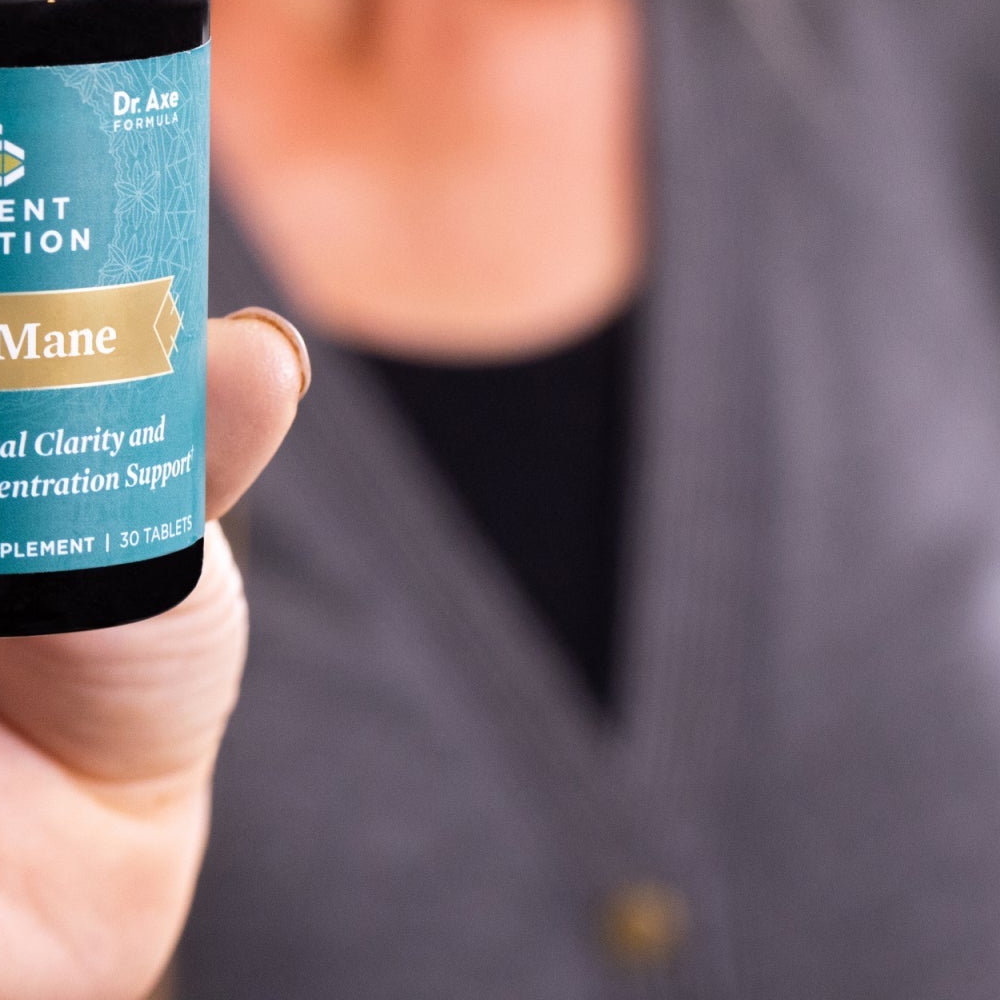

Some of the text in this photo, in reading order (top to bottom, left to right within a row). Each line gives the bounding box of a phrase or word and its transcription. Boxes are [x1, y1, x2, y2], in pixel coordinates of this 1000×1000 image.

[113, 87, 179, 116] Dr. Axe
[113, 111, 179, 132] FORMULA
[34, 426, 125, 457] Clarity
[128, 413, 166, 447] and
[120, 530, 140, 548] 30
[143, 515, 193, 543] TABLETS
